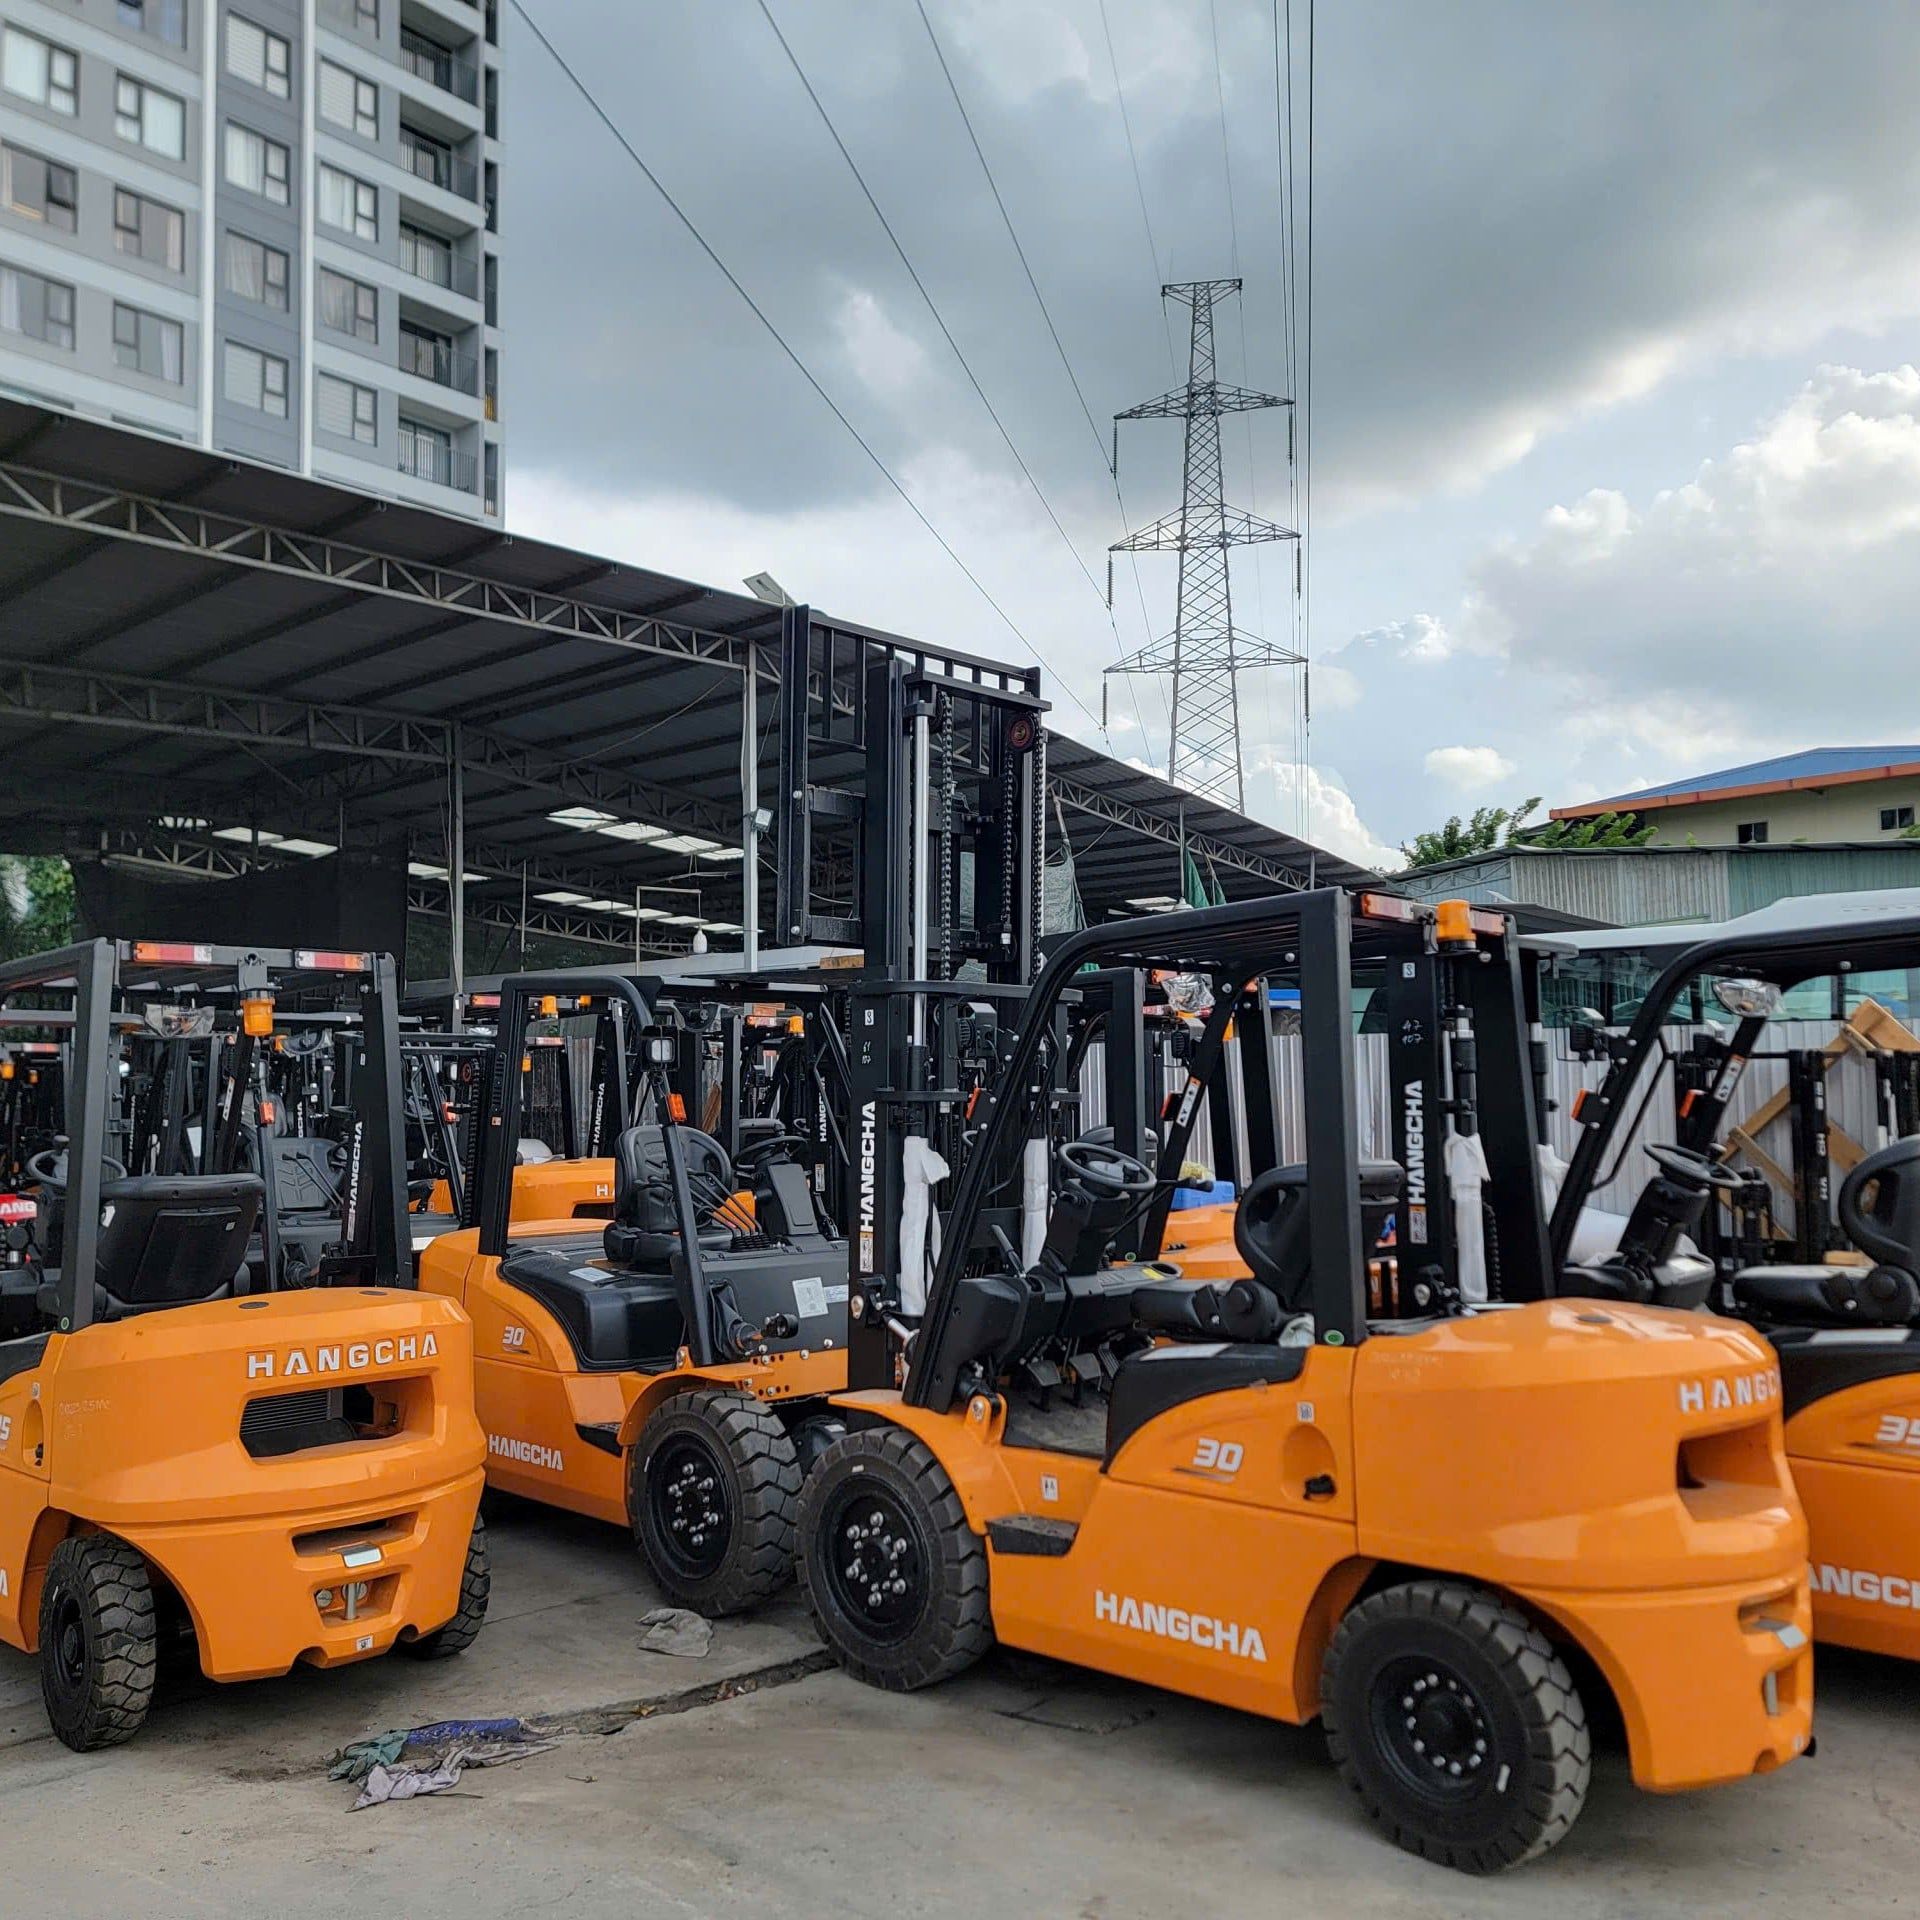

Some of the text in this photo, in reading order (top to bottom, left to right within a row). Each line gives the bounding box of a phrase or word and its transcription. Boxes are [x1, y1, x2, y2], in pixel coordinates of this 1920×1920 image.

[593, 1082, 605, 1143] HANGCHA
[349, 1121, 363, 1213] HANGCHA
[860, 1101, 876, 1232] HANGCHA
[1404, 1080, 1426, 1205] HANGCHA
[596, 1184, 616, 1197] H
[248, 1332, 438, 1378] HANGCHA
[502, 1325, 525, 1346] 30
[489, 1433, 564, 1471] HANGCHA
[1193, 1437, 1244, 1472] 30
[1096, 1589, 1267, 1662] HANGCHA
